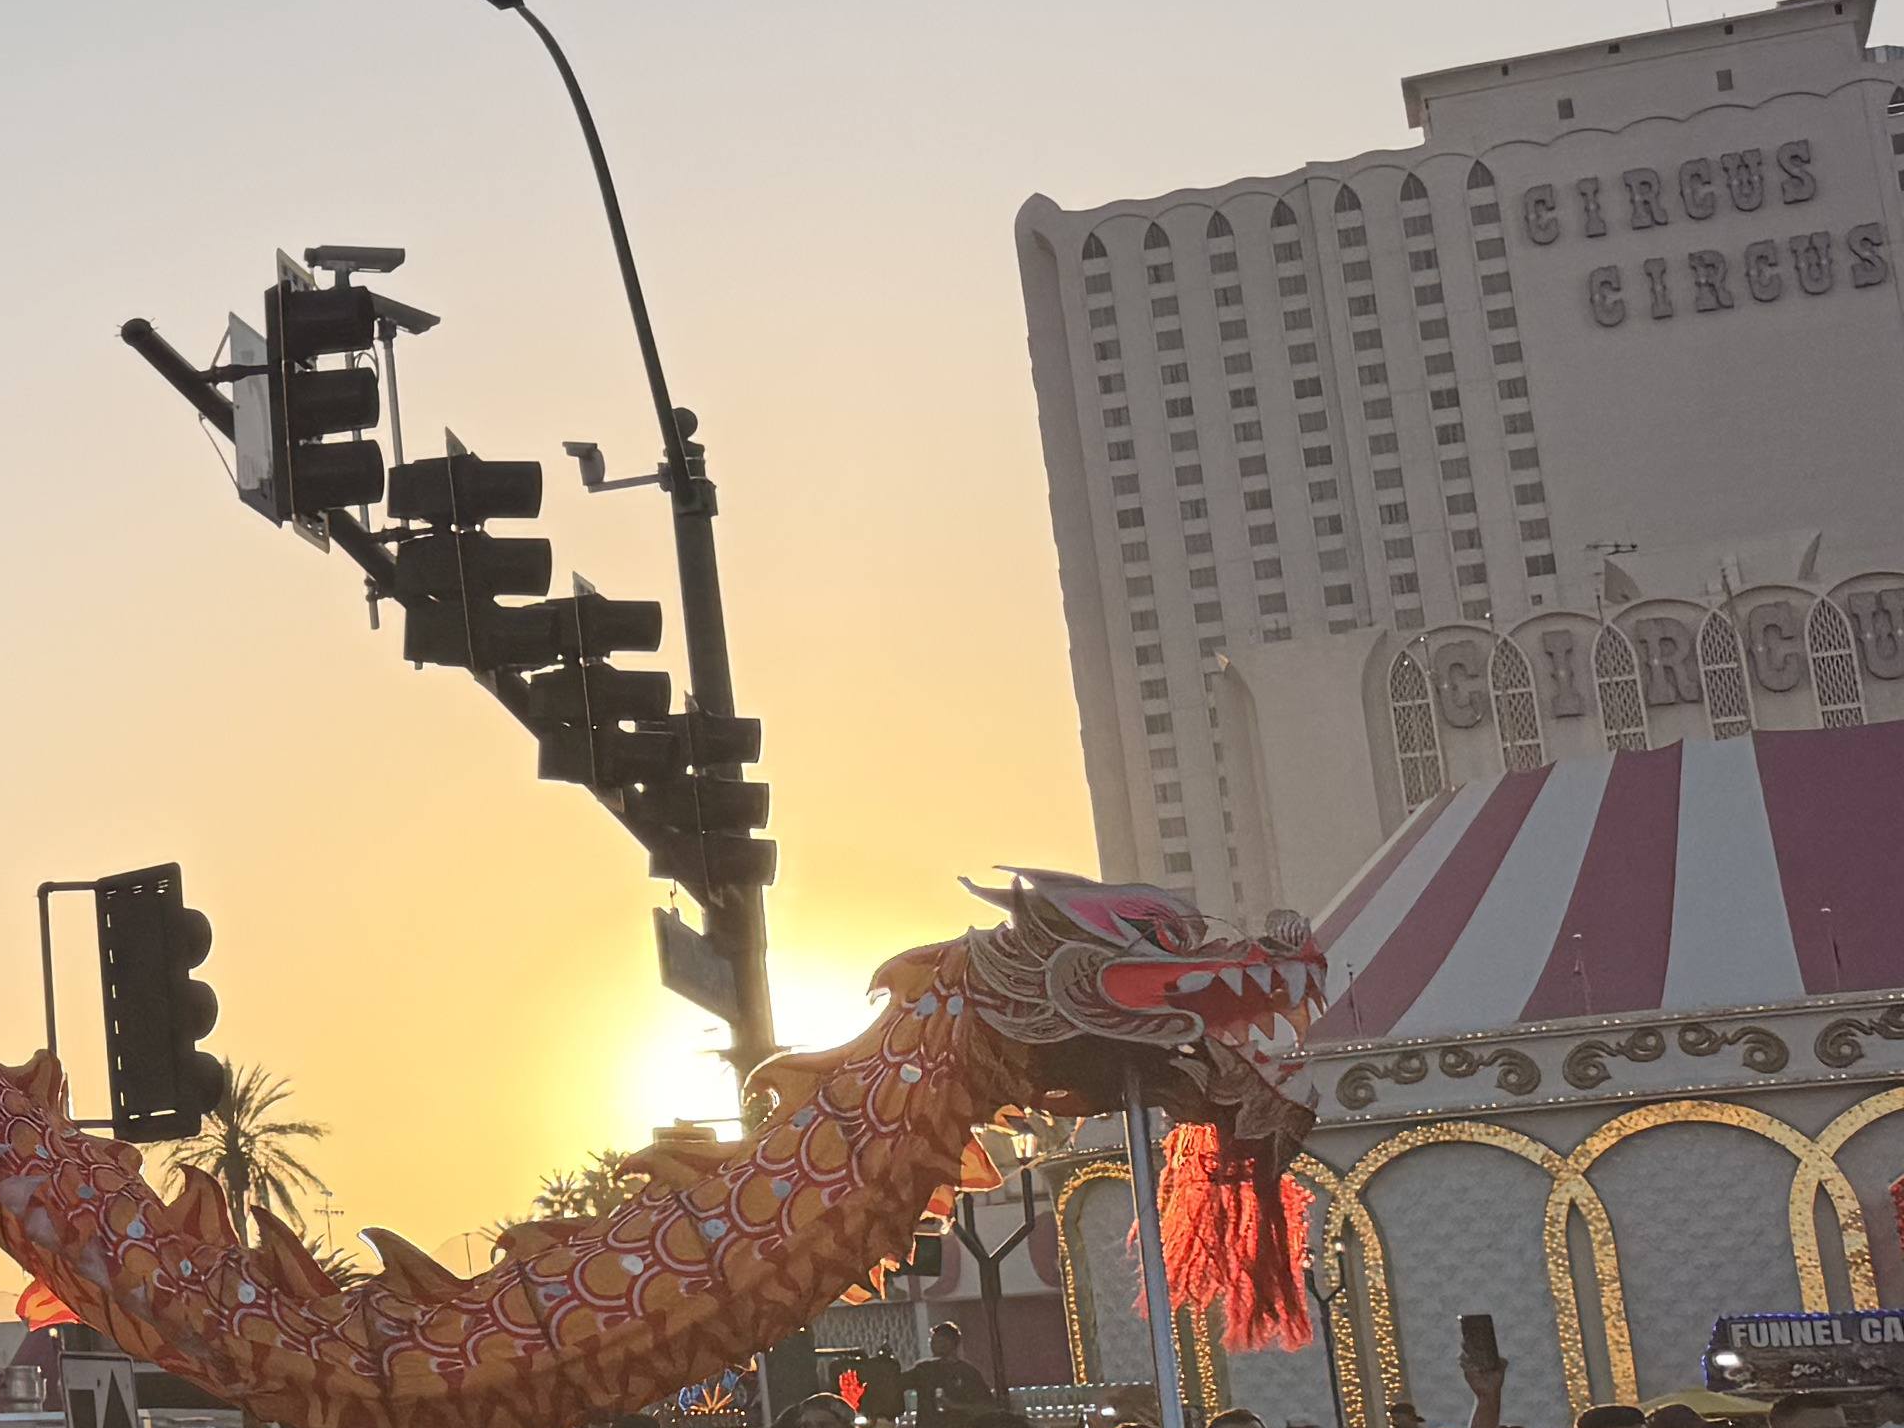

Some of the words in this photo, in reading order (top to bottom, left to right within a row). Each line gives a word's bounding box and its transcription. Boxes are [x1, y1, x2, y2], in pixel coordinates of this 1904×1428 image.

[1523, 138, 1817, 246] CIRCUS
[1589, 221, 1890, 328] CIRCUS
[1730, 1319, 1852, 1349] FUNNEL
